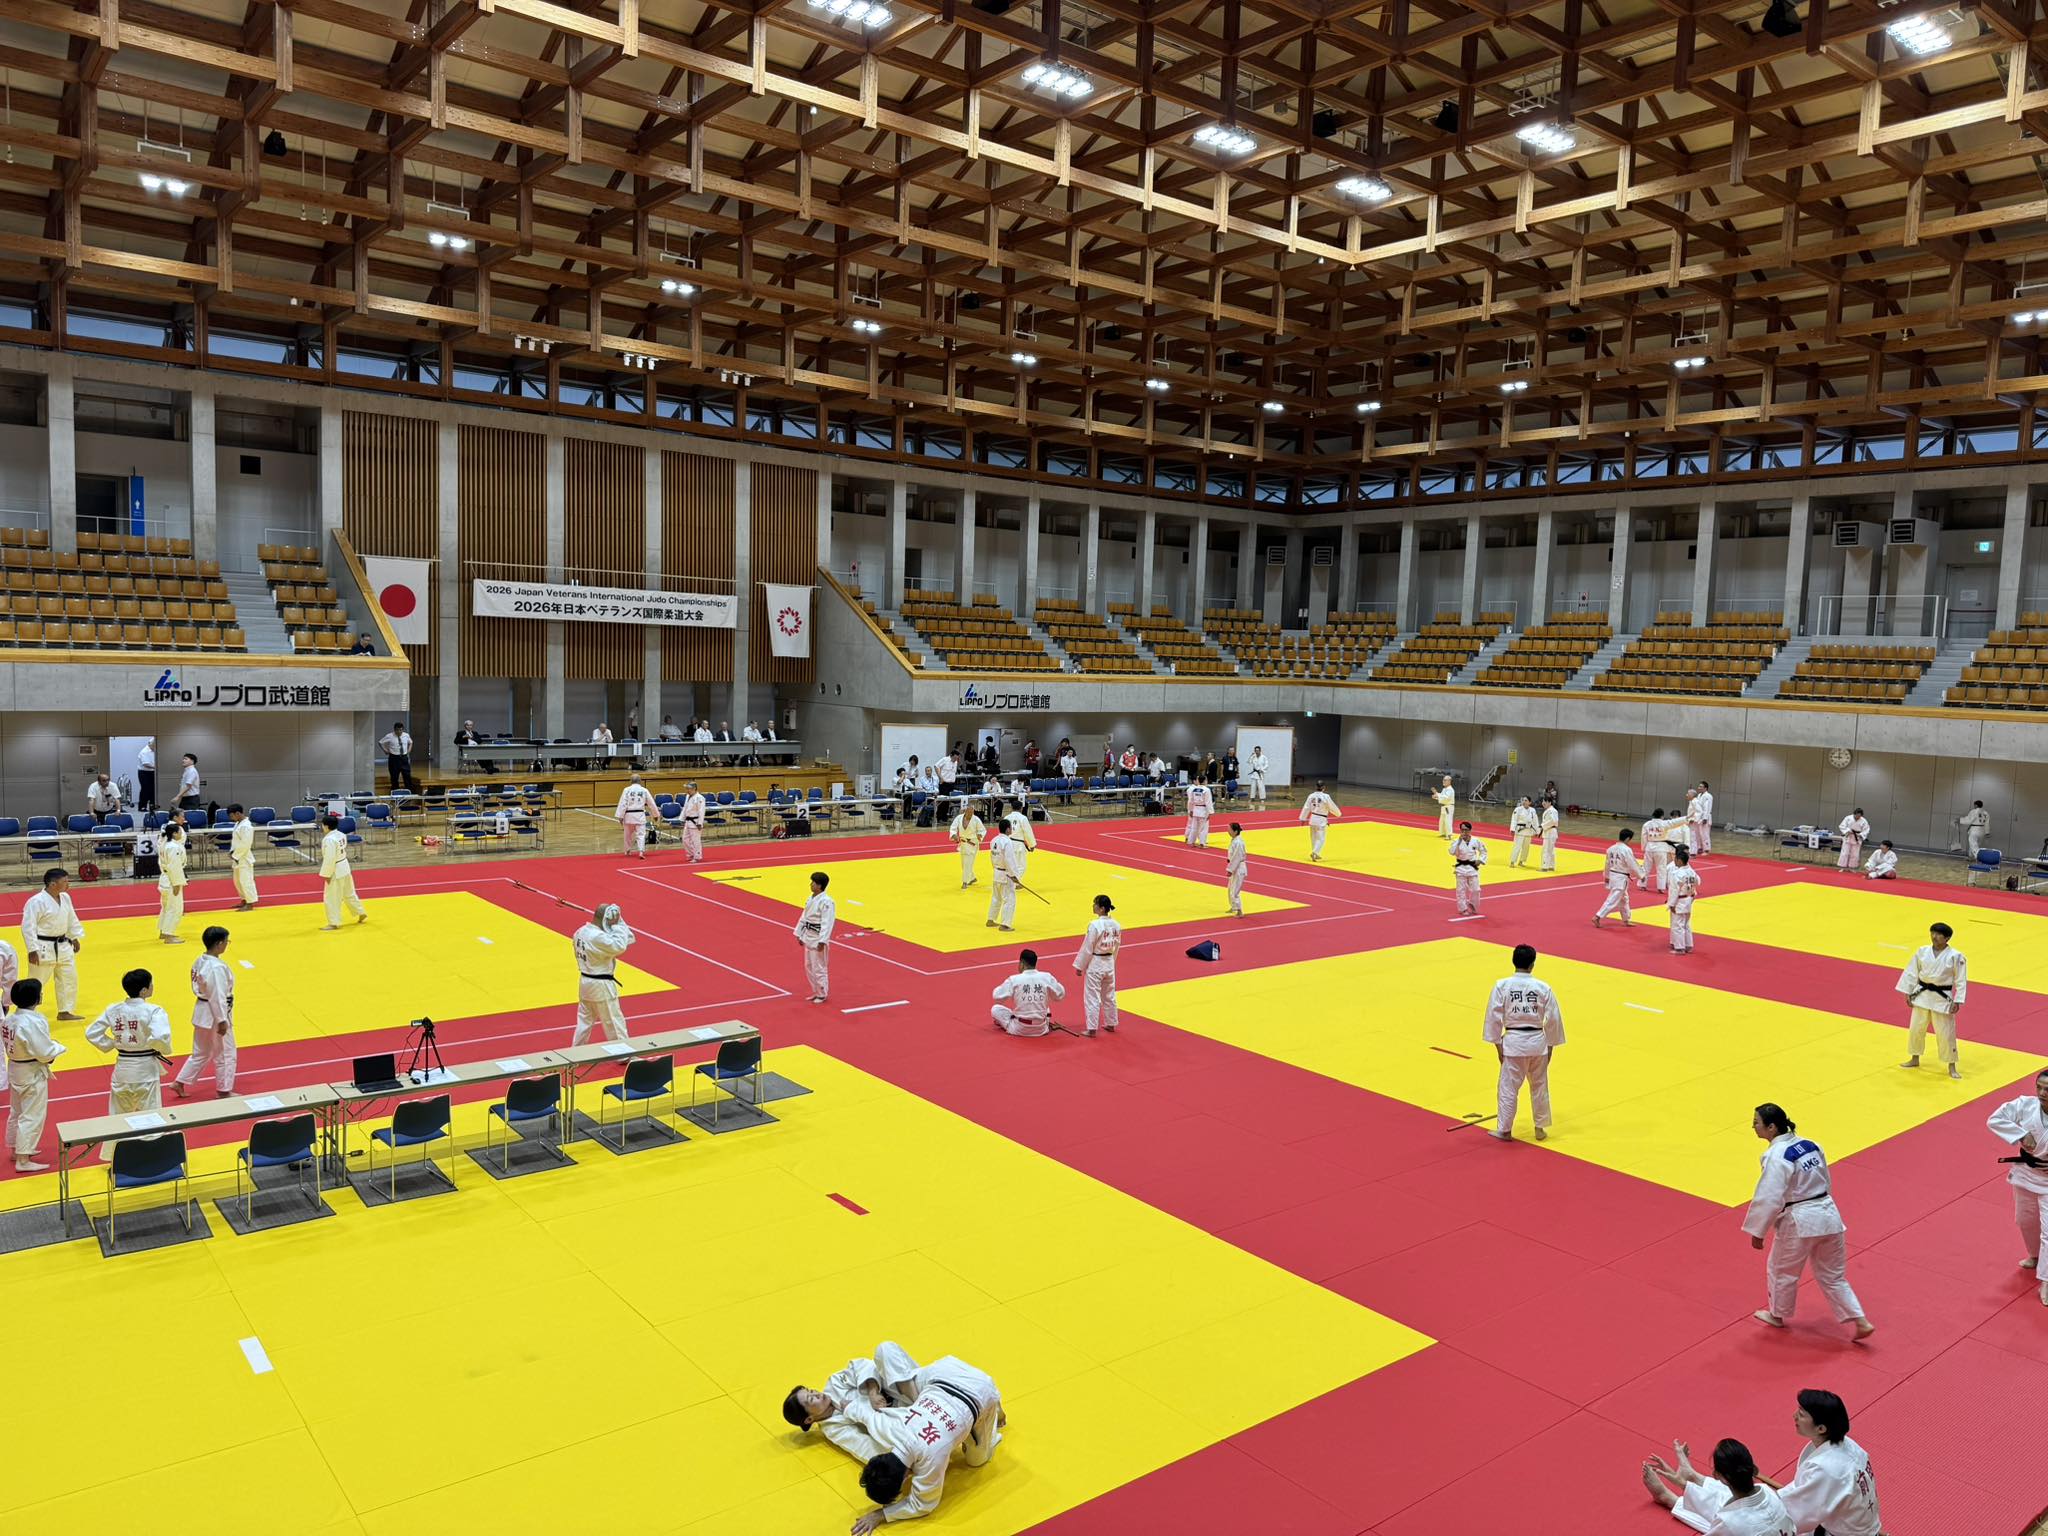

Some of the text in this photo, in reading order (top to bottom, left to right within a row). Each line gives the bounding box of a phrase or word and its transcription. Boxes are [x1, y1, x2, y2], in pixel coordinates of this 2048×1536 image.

[486, 585, 727, 608] 2026 Japan Veterans International Judo Championships
[514, 601, 704, 621] 2026年日本ベテランズ国際柔道大会
[196, 684, 331, 706] リプロ武道館
[984, 694, 1051, 709] リプロ武道館
[799, 808, 807, 819] 2
[140, 840, 154, 855] 3
[1510, 990, 1538, 1003] 河合
[1802, 1157, 1821, 1172] HKG
[904, 1408, 942, 1446] 坂上
